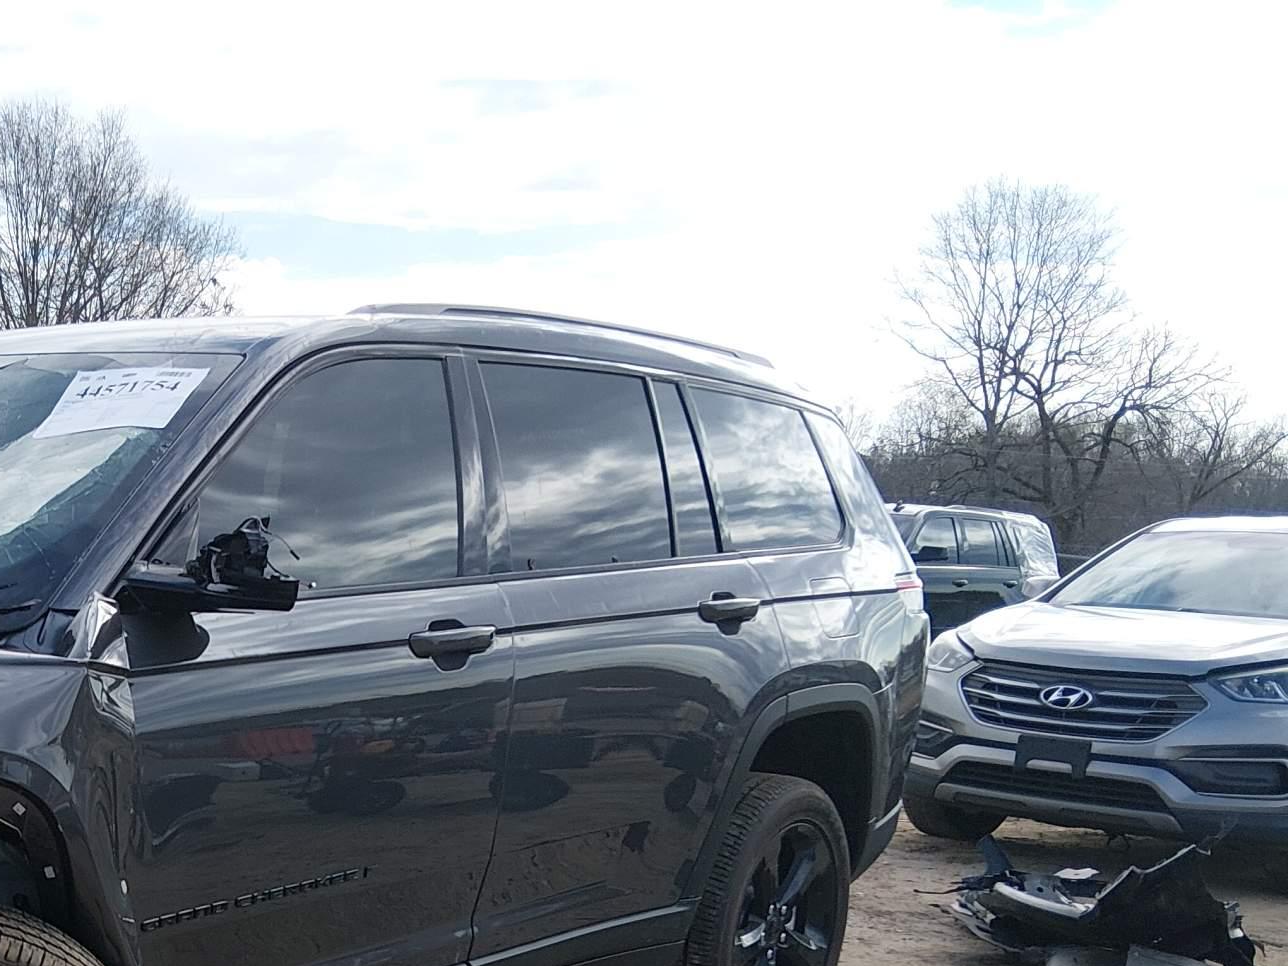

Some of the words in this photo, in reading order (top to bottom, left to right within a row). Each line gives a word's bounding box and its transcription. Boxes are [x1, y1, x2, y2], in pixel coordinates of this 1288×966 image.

[76, 380, 181, 399] 44571754
[140, 900, 228, 932] GRAND
[234, 868, 361, 908] CHEROKEE
